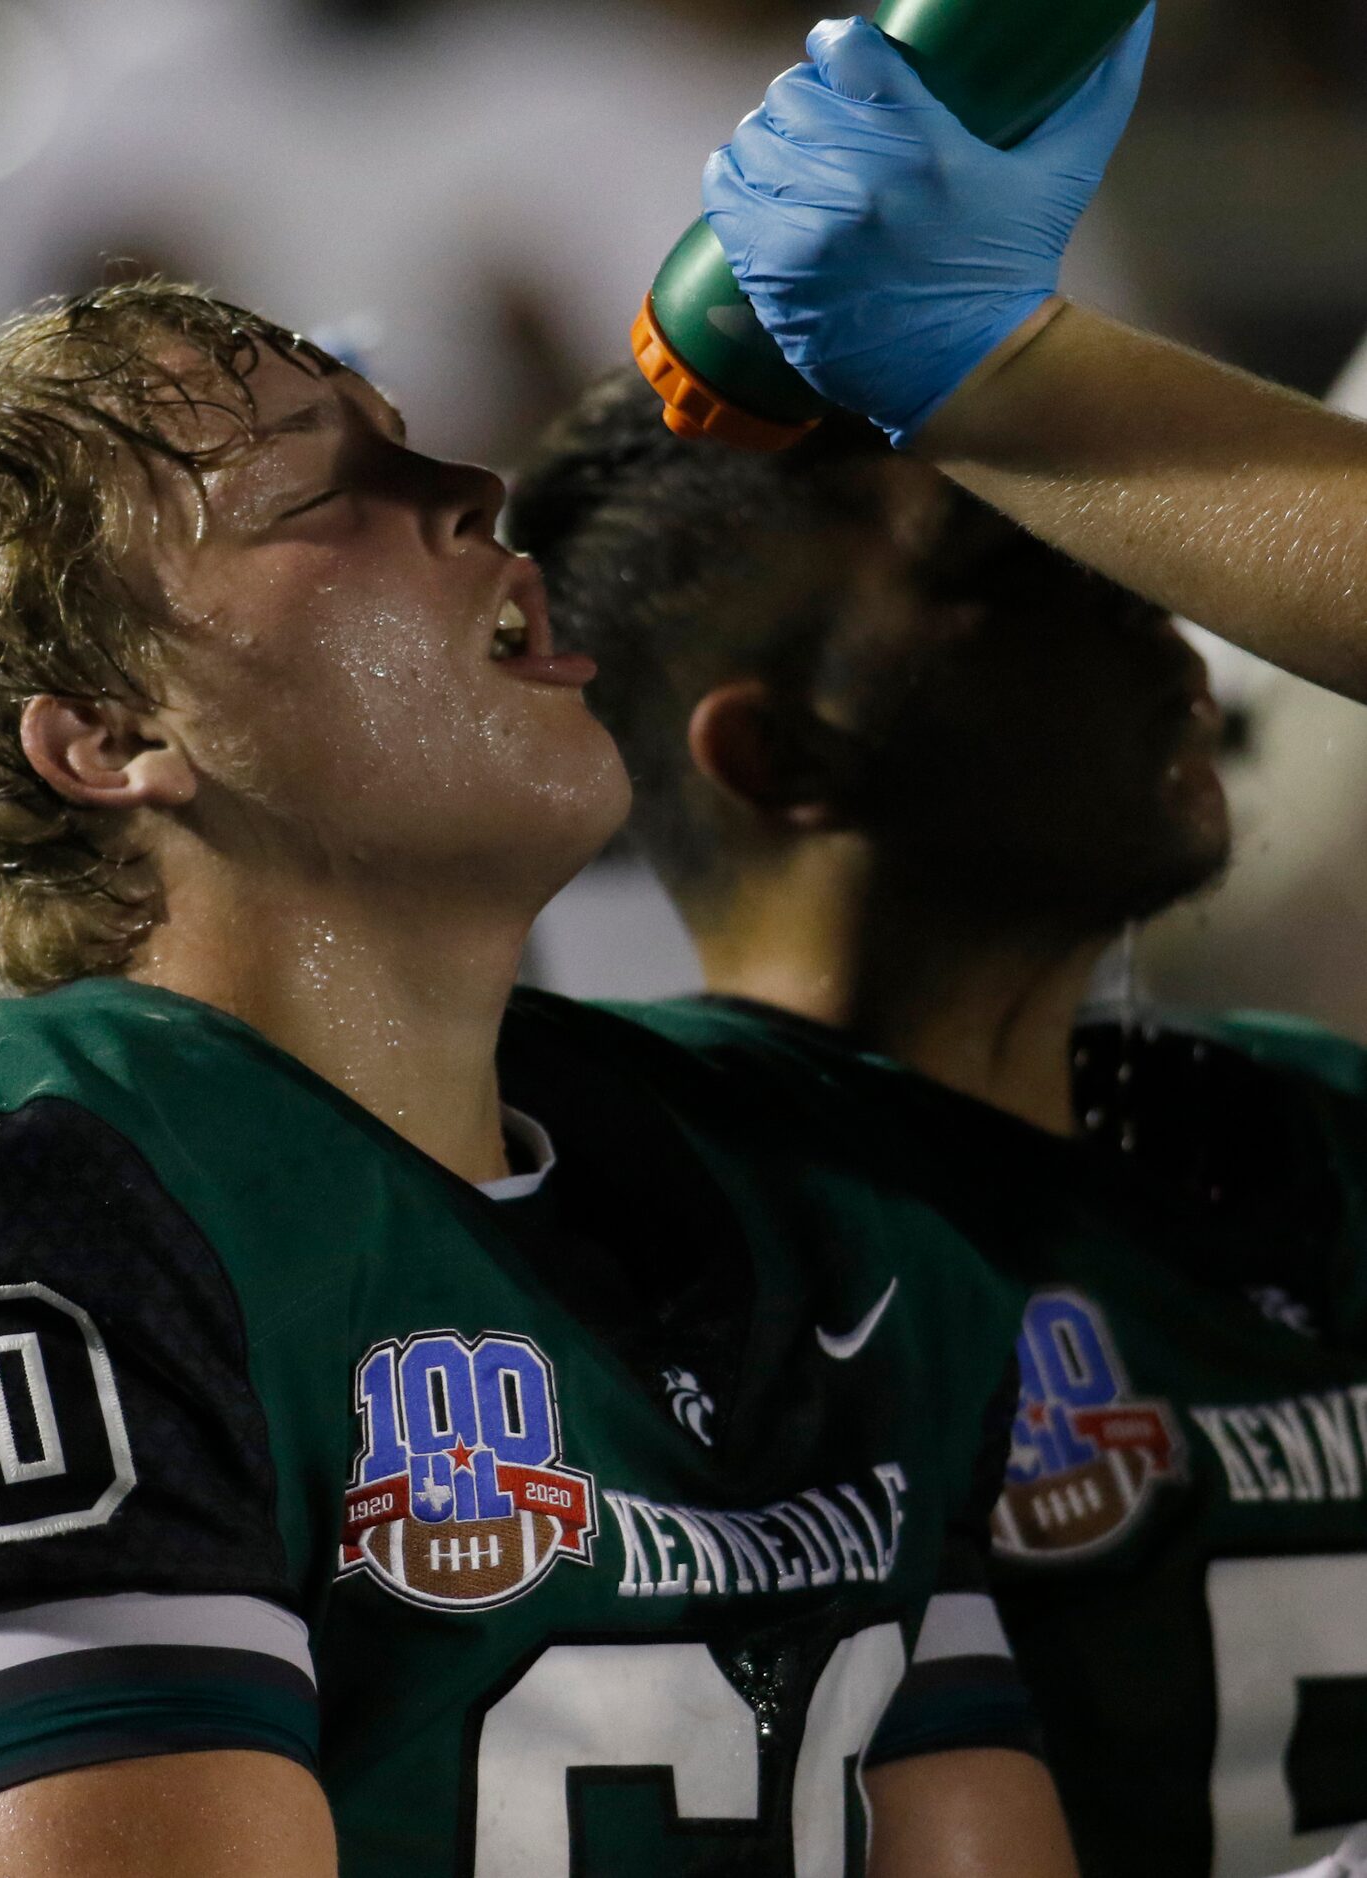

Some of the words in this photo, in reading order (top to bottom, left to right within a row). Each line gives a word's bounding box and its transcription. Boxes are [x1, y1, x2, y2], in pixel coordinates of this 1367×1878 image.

[358, 1335, 557, 1487] 100
[347, 1492, 394, 1523] 1920
[407, 1446, 515, 1524] UIL
[525, 1481, 571, 1509] 2020
[601, 1462, 908, 1597] KENNEDALE
